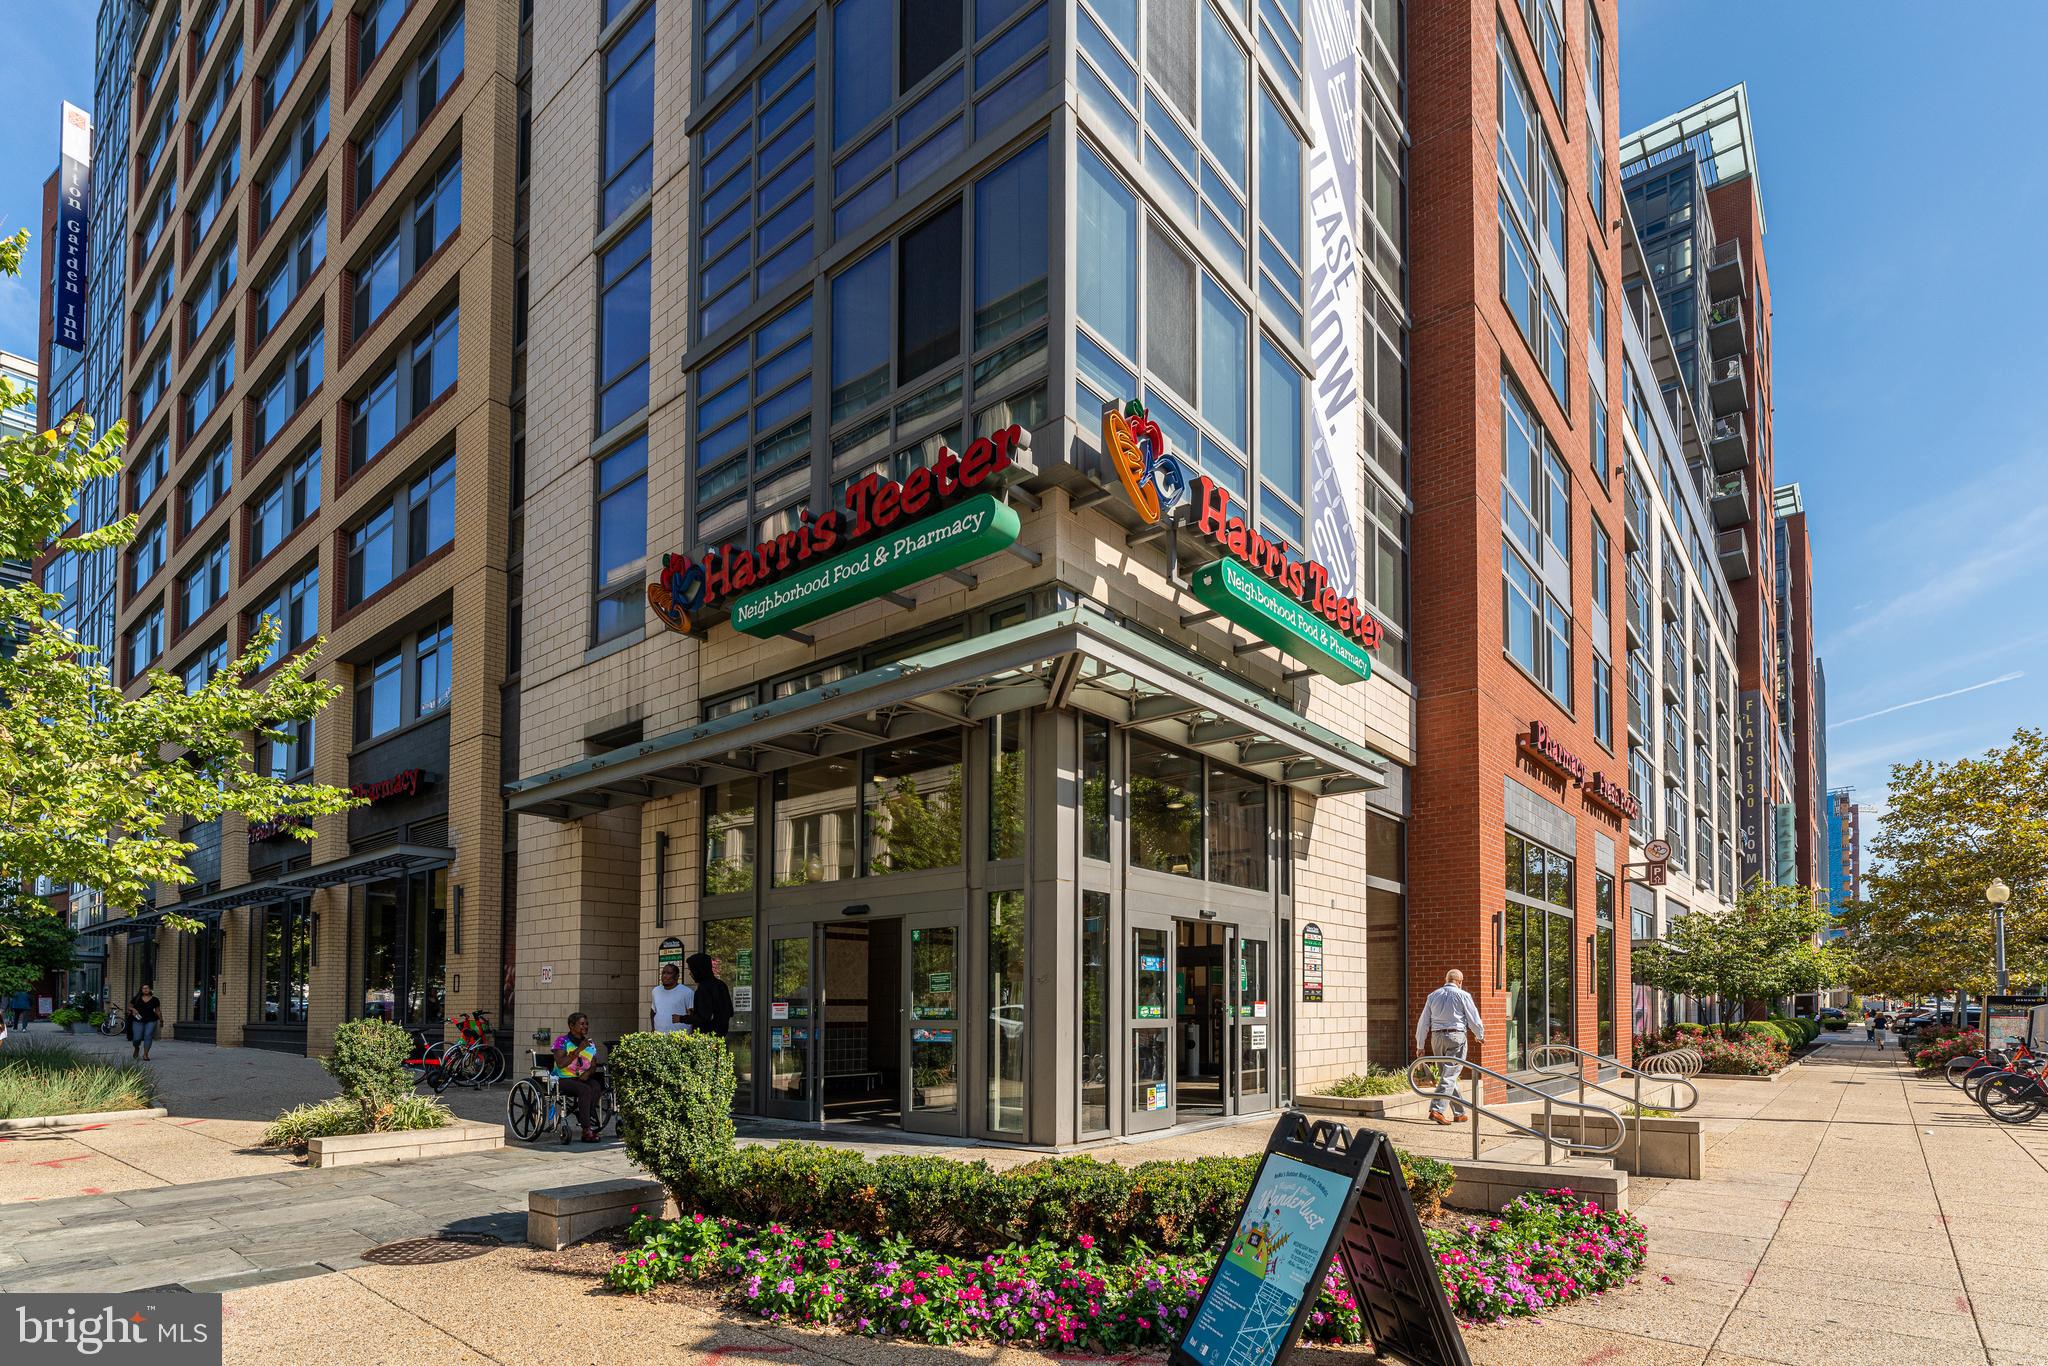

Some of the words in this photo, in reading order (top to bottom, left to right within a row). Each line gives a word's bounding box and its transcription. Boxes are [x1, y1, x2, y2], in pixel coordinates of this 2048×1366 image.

[1327, 72, 1356, 165] OFF
[65, 220, 80, 293] Garden
[63, 303, 77, 341] Inn
[704, 509, 837, 603] Harris
[846, 424, 1023, 537] Teeter
[737, 570, 830, 623] Neighborhood
[833, 558, 870, 584] Food
[873, 547, 890, 567] &
[893, 510, 985, 560] Pharmacy
[1198, 475, 1305, 600] Harris
[1309, 559, 1384, 651] Teeter
[1226, 567, 1297, 627] Neighborhood
[1297, 614, 1319, 641] Food
[1319, 630, 1329, 646] &
[1329, 635, 1368, 676] Pharmacy
[1537, 719, 1586, 789] Pharmacy
[1600, 771, 1622, 806] Fresh
[1653, 867, 1662, 876] P
[542, 968, 552, 981] FDC
[1257, 1185, 1325, 1231] Wanderlust
